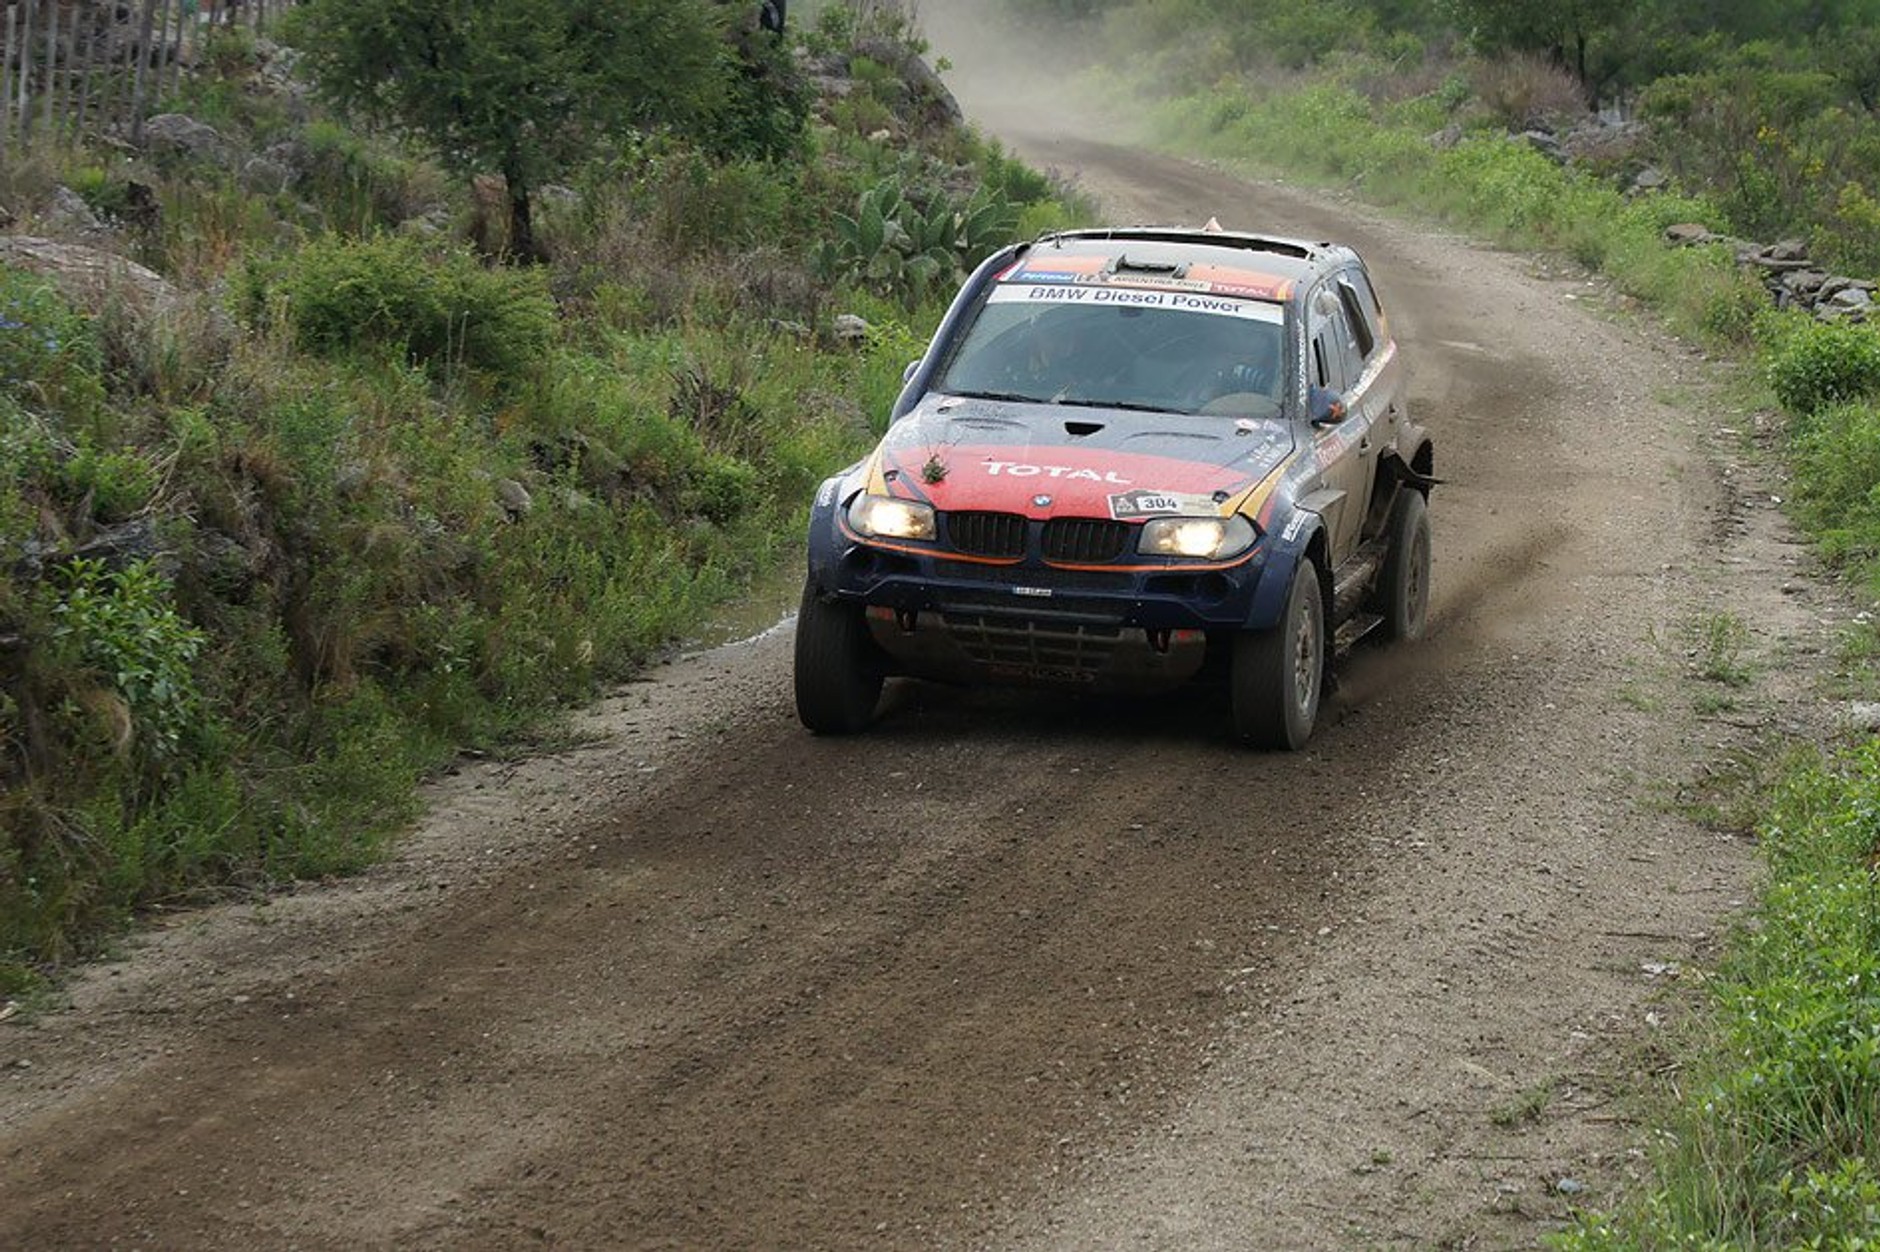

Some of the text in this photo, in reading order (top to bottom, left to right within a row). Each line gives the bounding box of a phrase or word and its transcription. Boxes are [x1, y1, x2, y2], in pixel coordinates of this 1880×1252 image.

[1216, 284, 1269, 297] TOTAL
[1029, 287, 1243, 313] BMW Diesel Power
[980, 461, 1133, 484] TOTAL
[1144, 497, 1177, 509] 304
